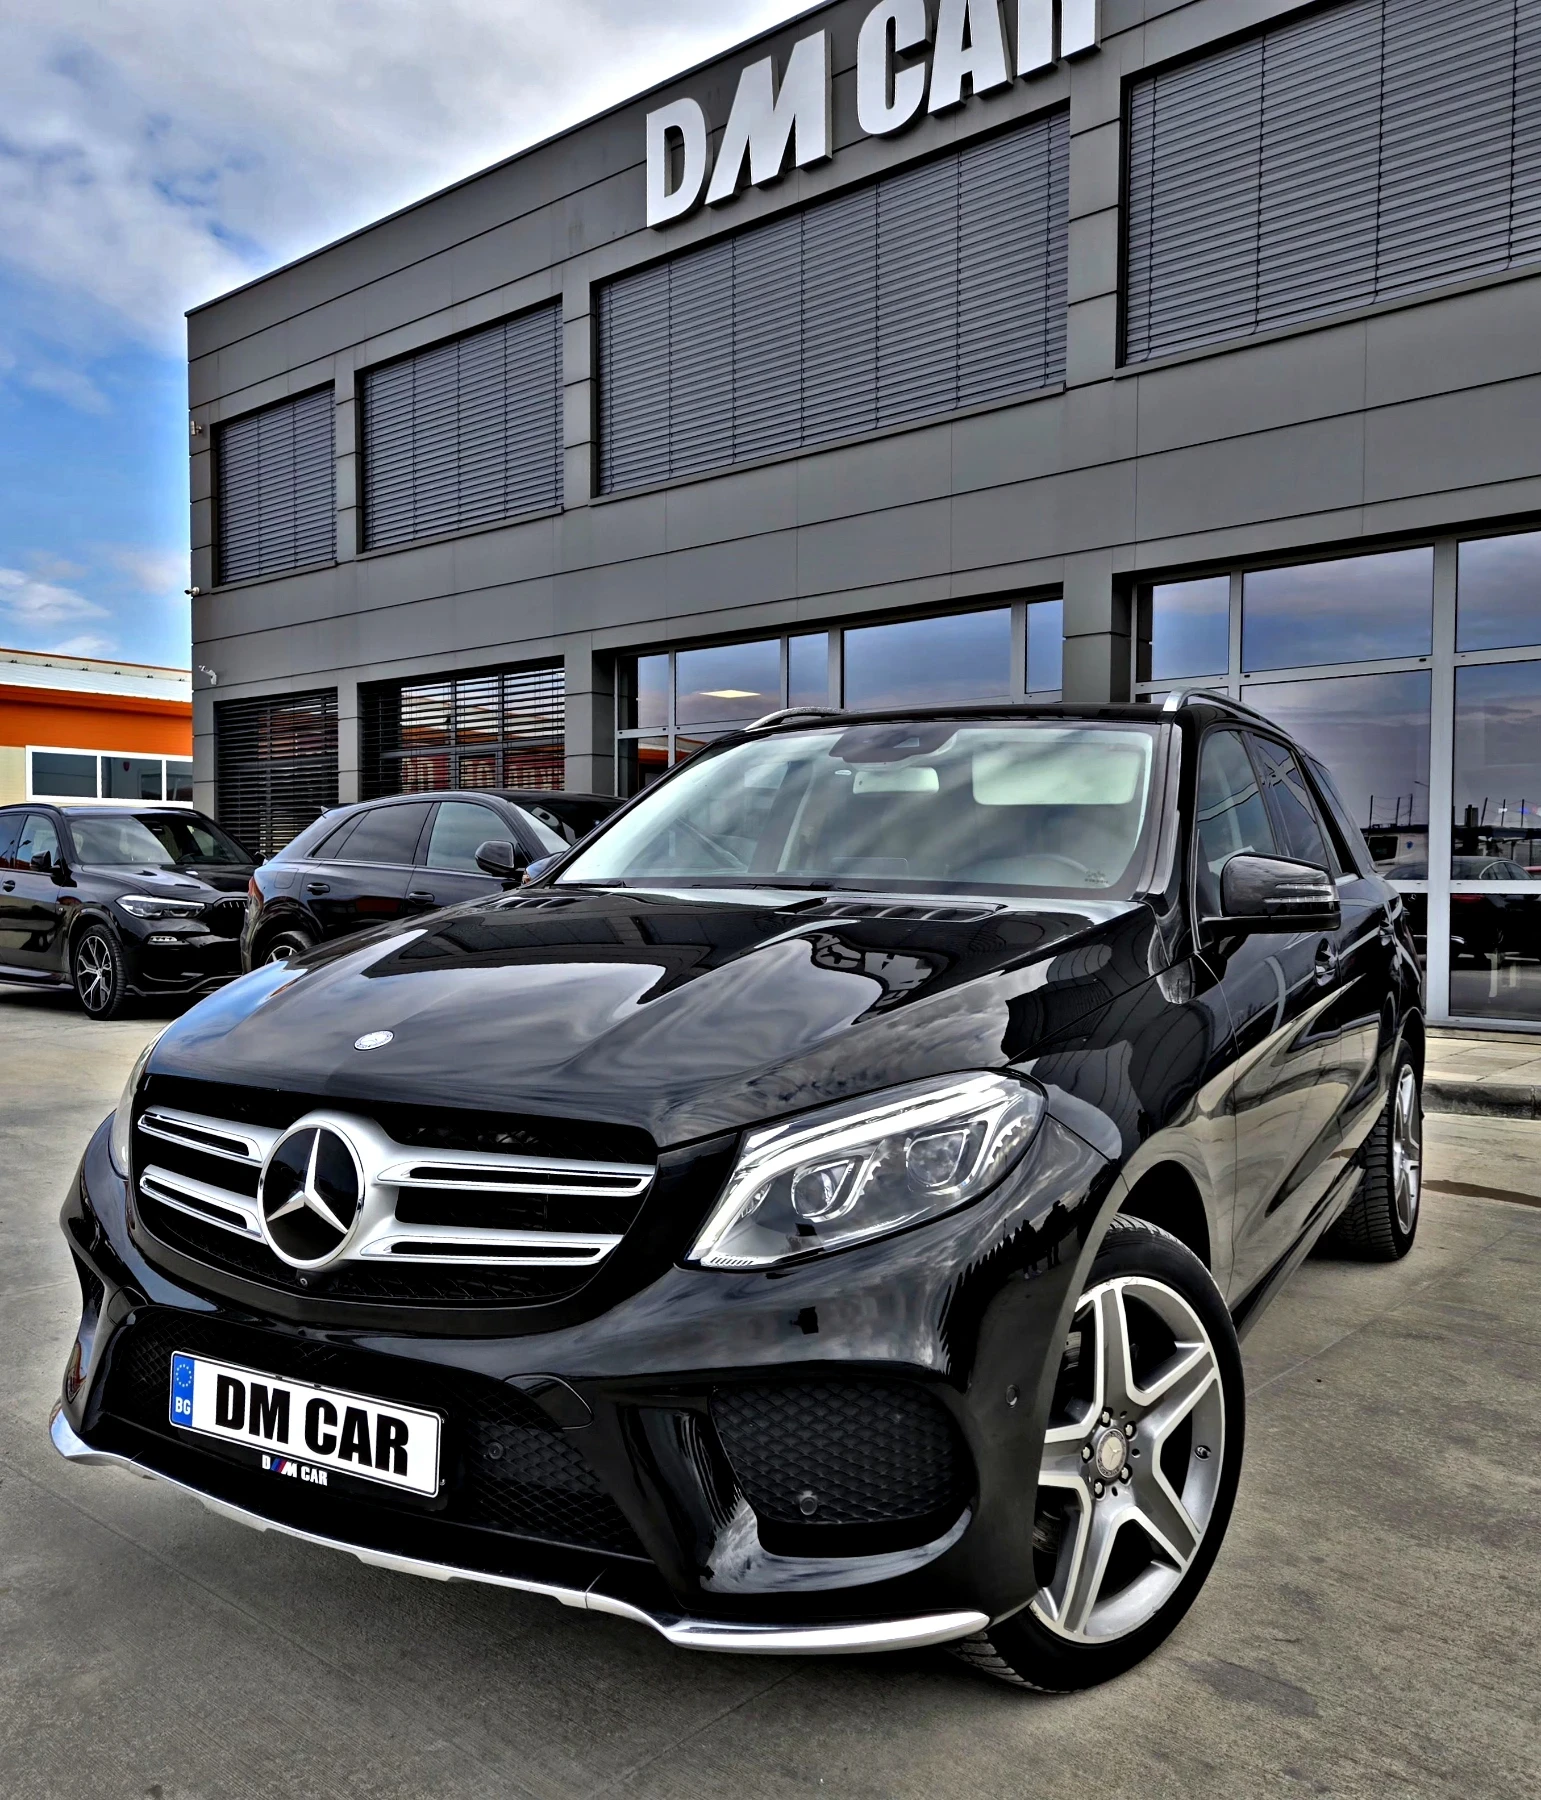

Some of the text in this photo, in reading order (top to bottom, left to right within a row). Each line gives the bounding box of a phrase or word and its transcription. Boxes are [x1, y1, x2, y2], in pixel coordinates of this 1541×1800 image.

[647, 29, 829, 229] DM
[175, 1396, 191, 1415] BG
[215, 1373, 410, 1476] DM CAR
[262, 1454, 328, 1486] DM CAR
